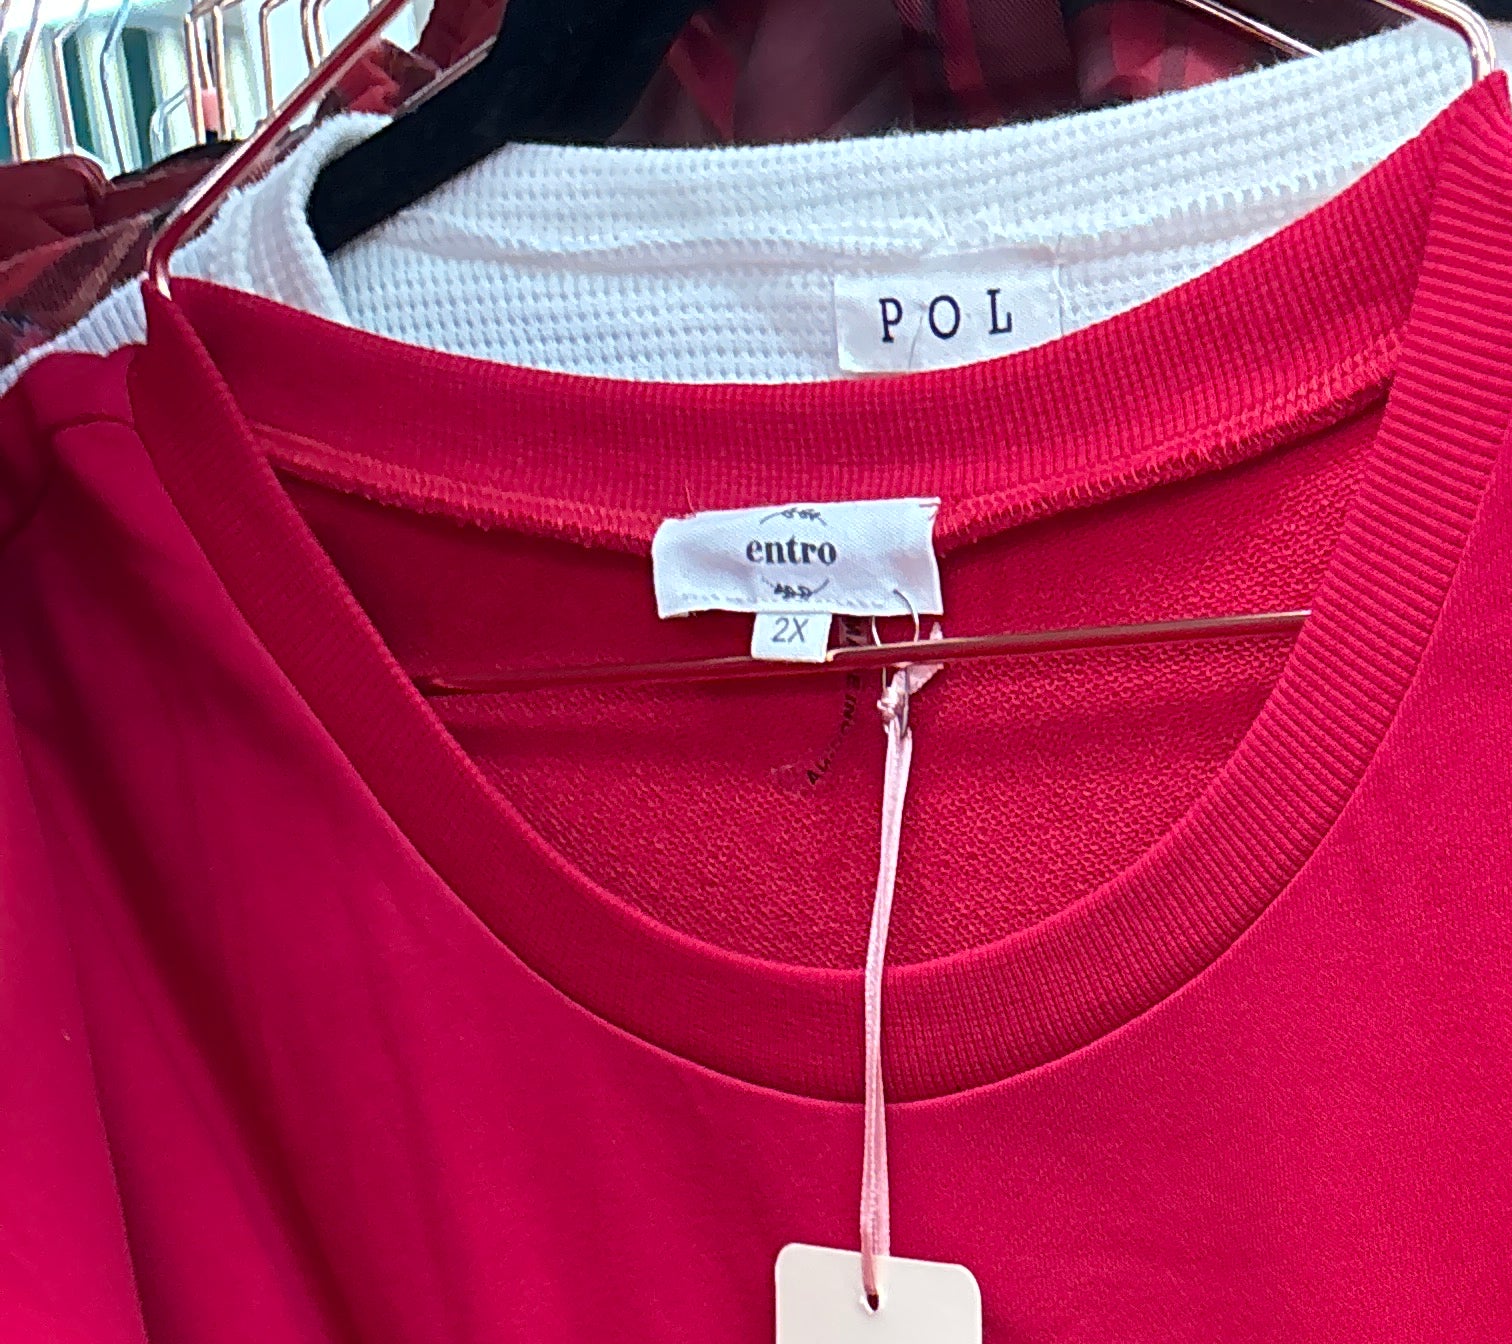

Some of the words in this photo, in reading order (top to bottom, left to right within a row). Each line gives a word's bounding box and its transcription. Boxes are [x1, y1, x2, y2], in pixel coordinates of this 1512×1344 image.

[878, 288, 1013, 343] POL
[745, 534, 837, 566] entro
[771, 617, 809, 643] 2X
